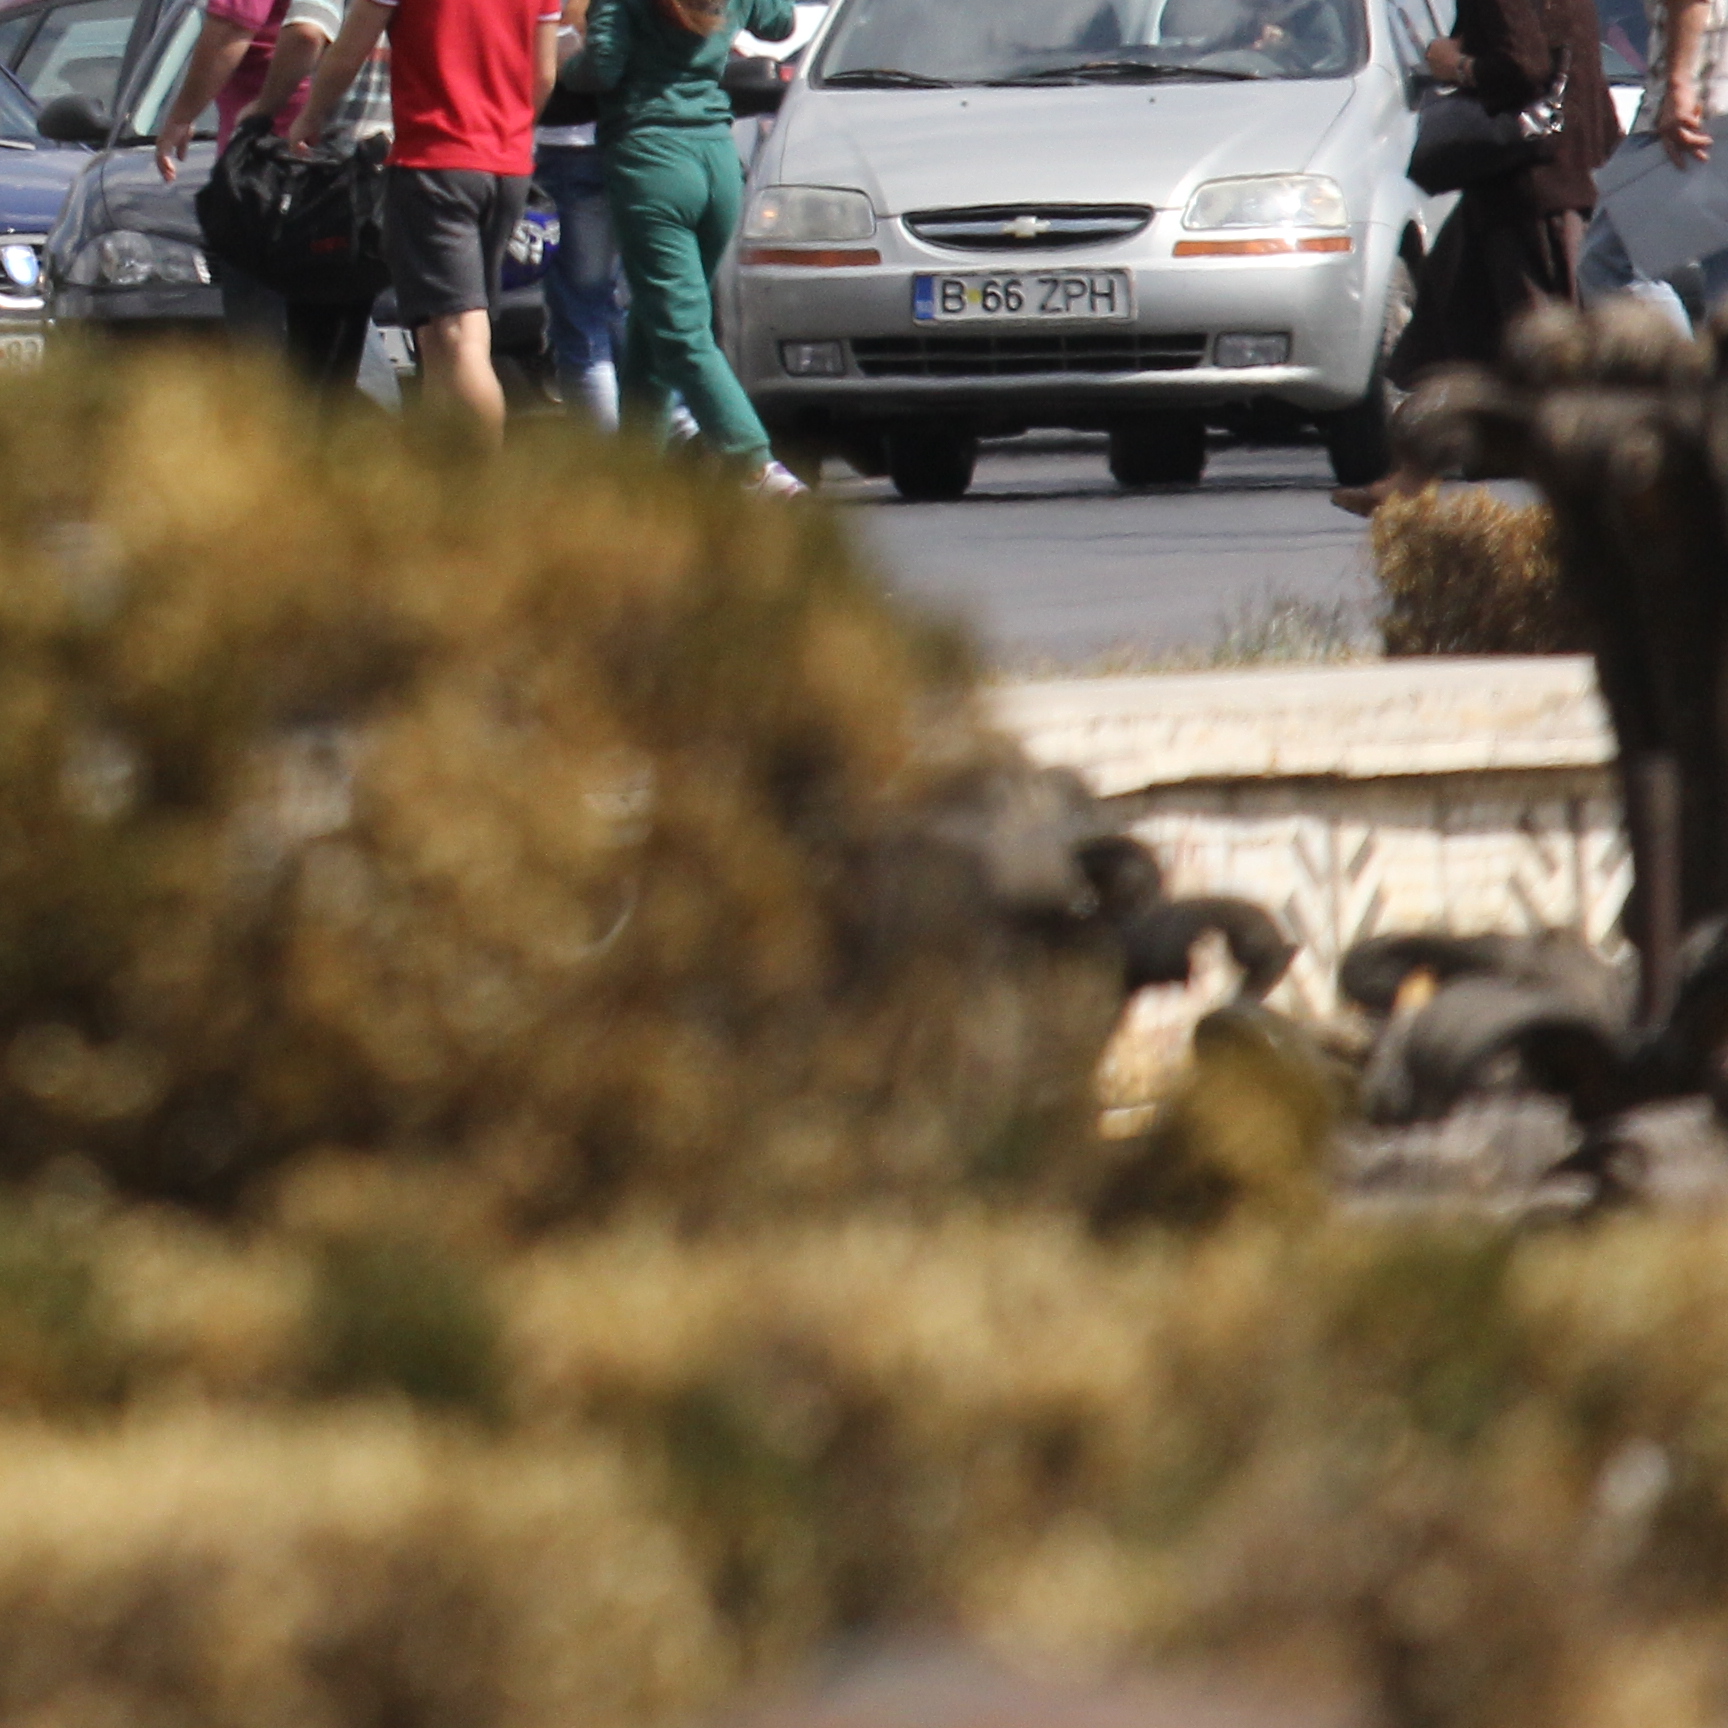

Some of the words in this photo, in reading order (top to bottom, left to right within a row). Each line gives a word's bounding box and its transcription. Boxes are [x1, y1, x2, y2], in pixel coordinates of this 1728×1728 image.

[942, 279, 966, 314] B
[982, 279, 1024, 313] 66
[1038, 277, 1116, 313] ZPH
